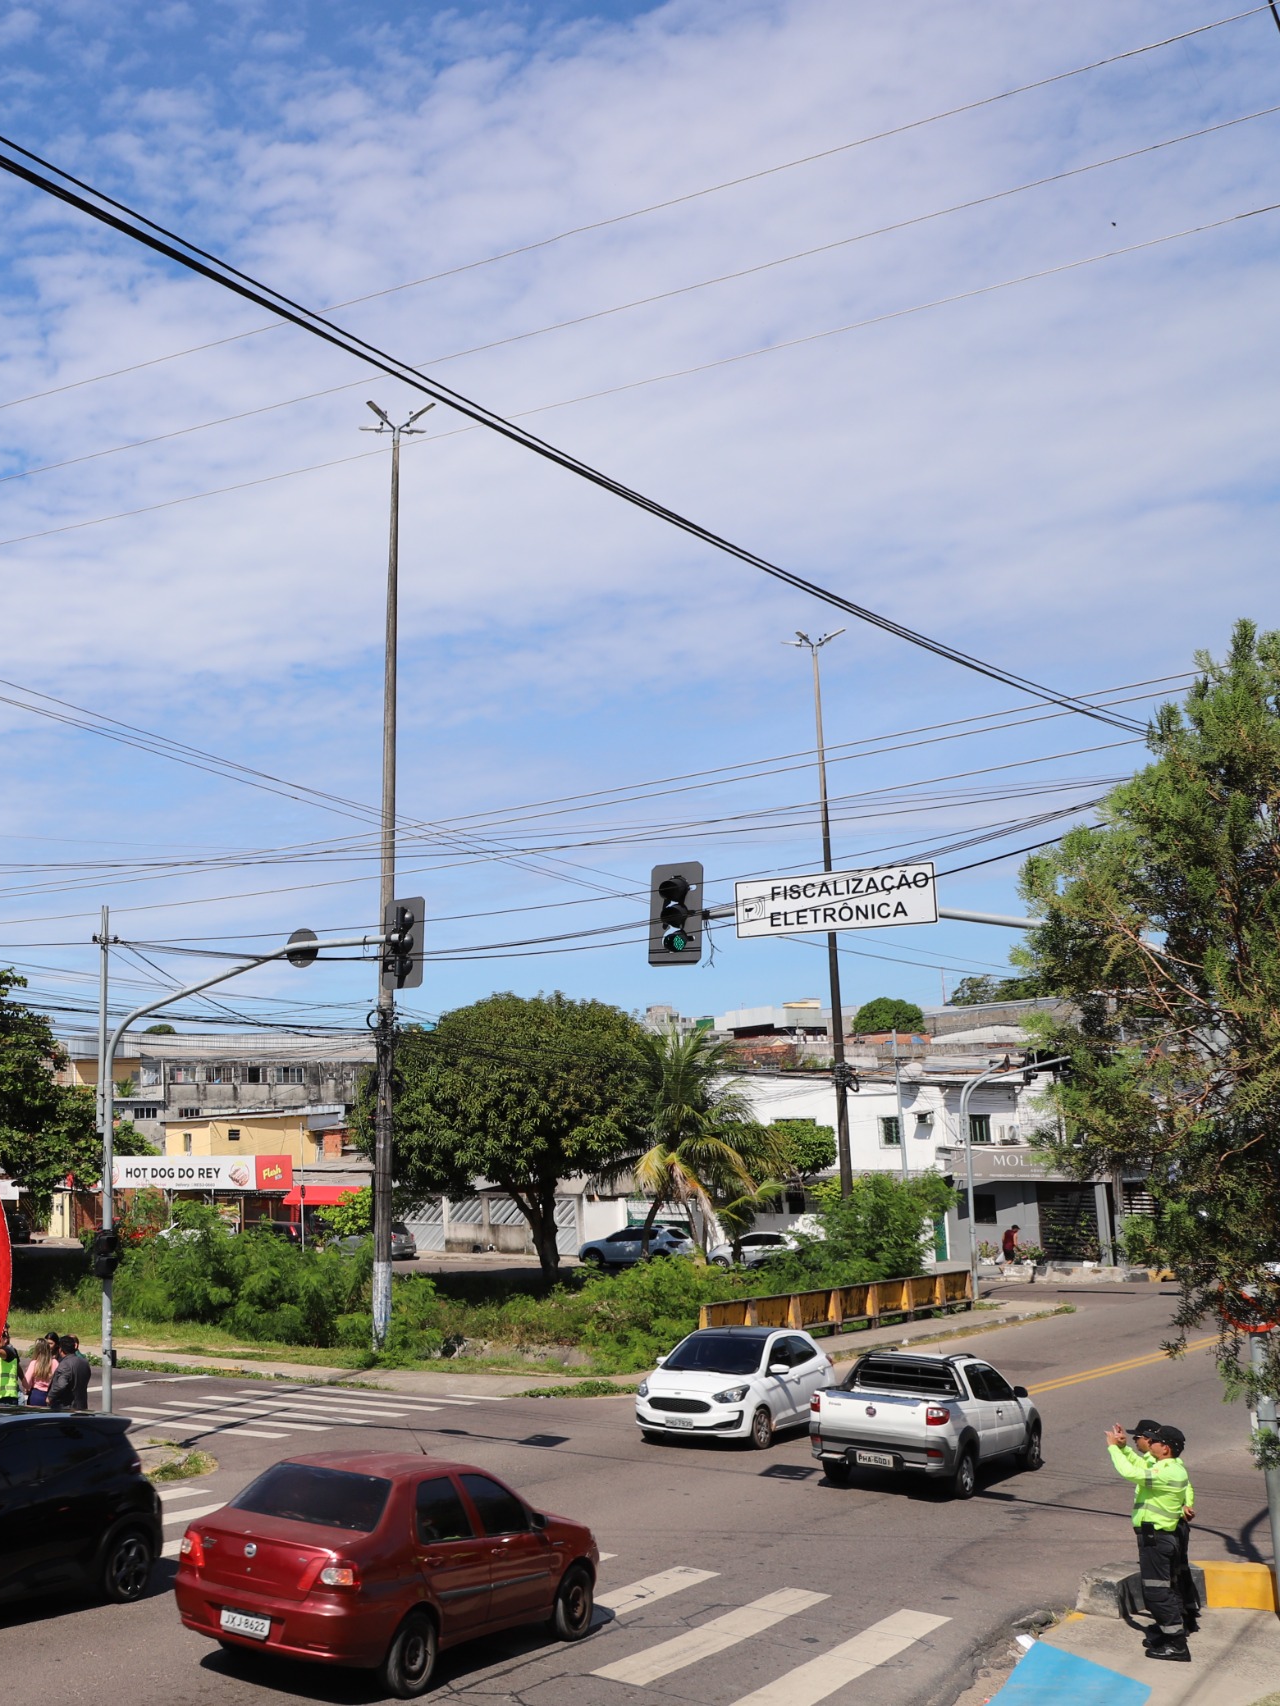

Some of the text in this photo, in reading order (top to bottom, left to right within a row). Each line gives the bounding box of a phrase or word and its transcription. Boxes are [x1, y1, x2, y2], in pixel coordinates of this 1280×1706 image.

[771, 869, 929, 901] FISCALIZAÇÃO
[770, 900, 908, 927] ELETRÔNICA
[125, 1168, 221, 1179] HOT DOG DO REY
